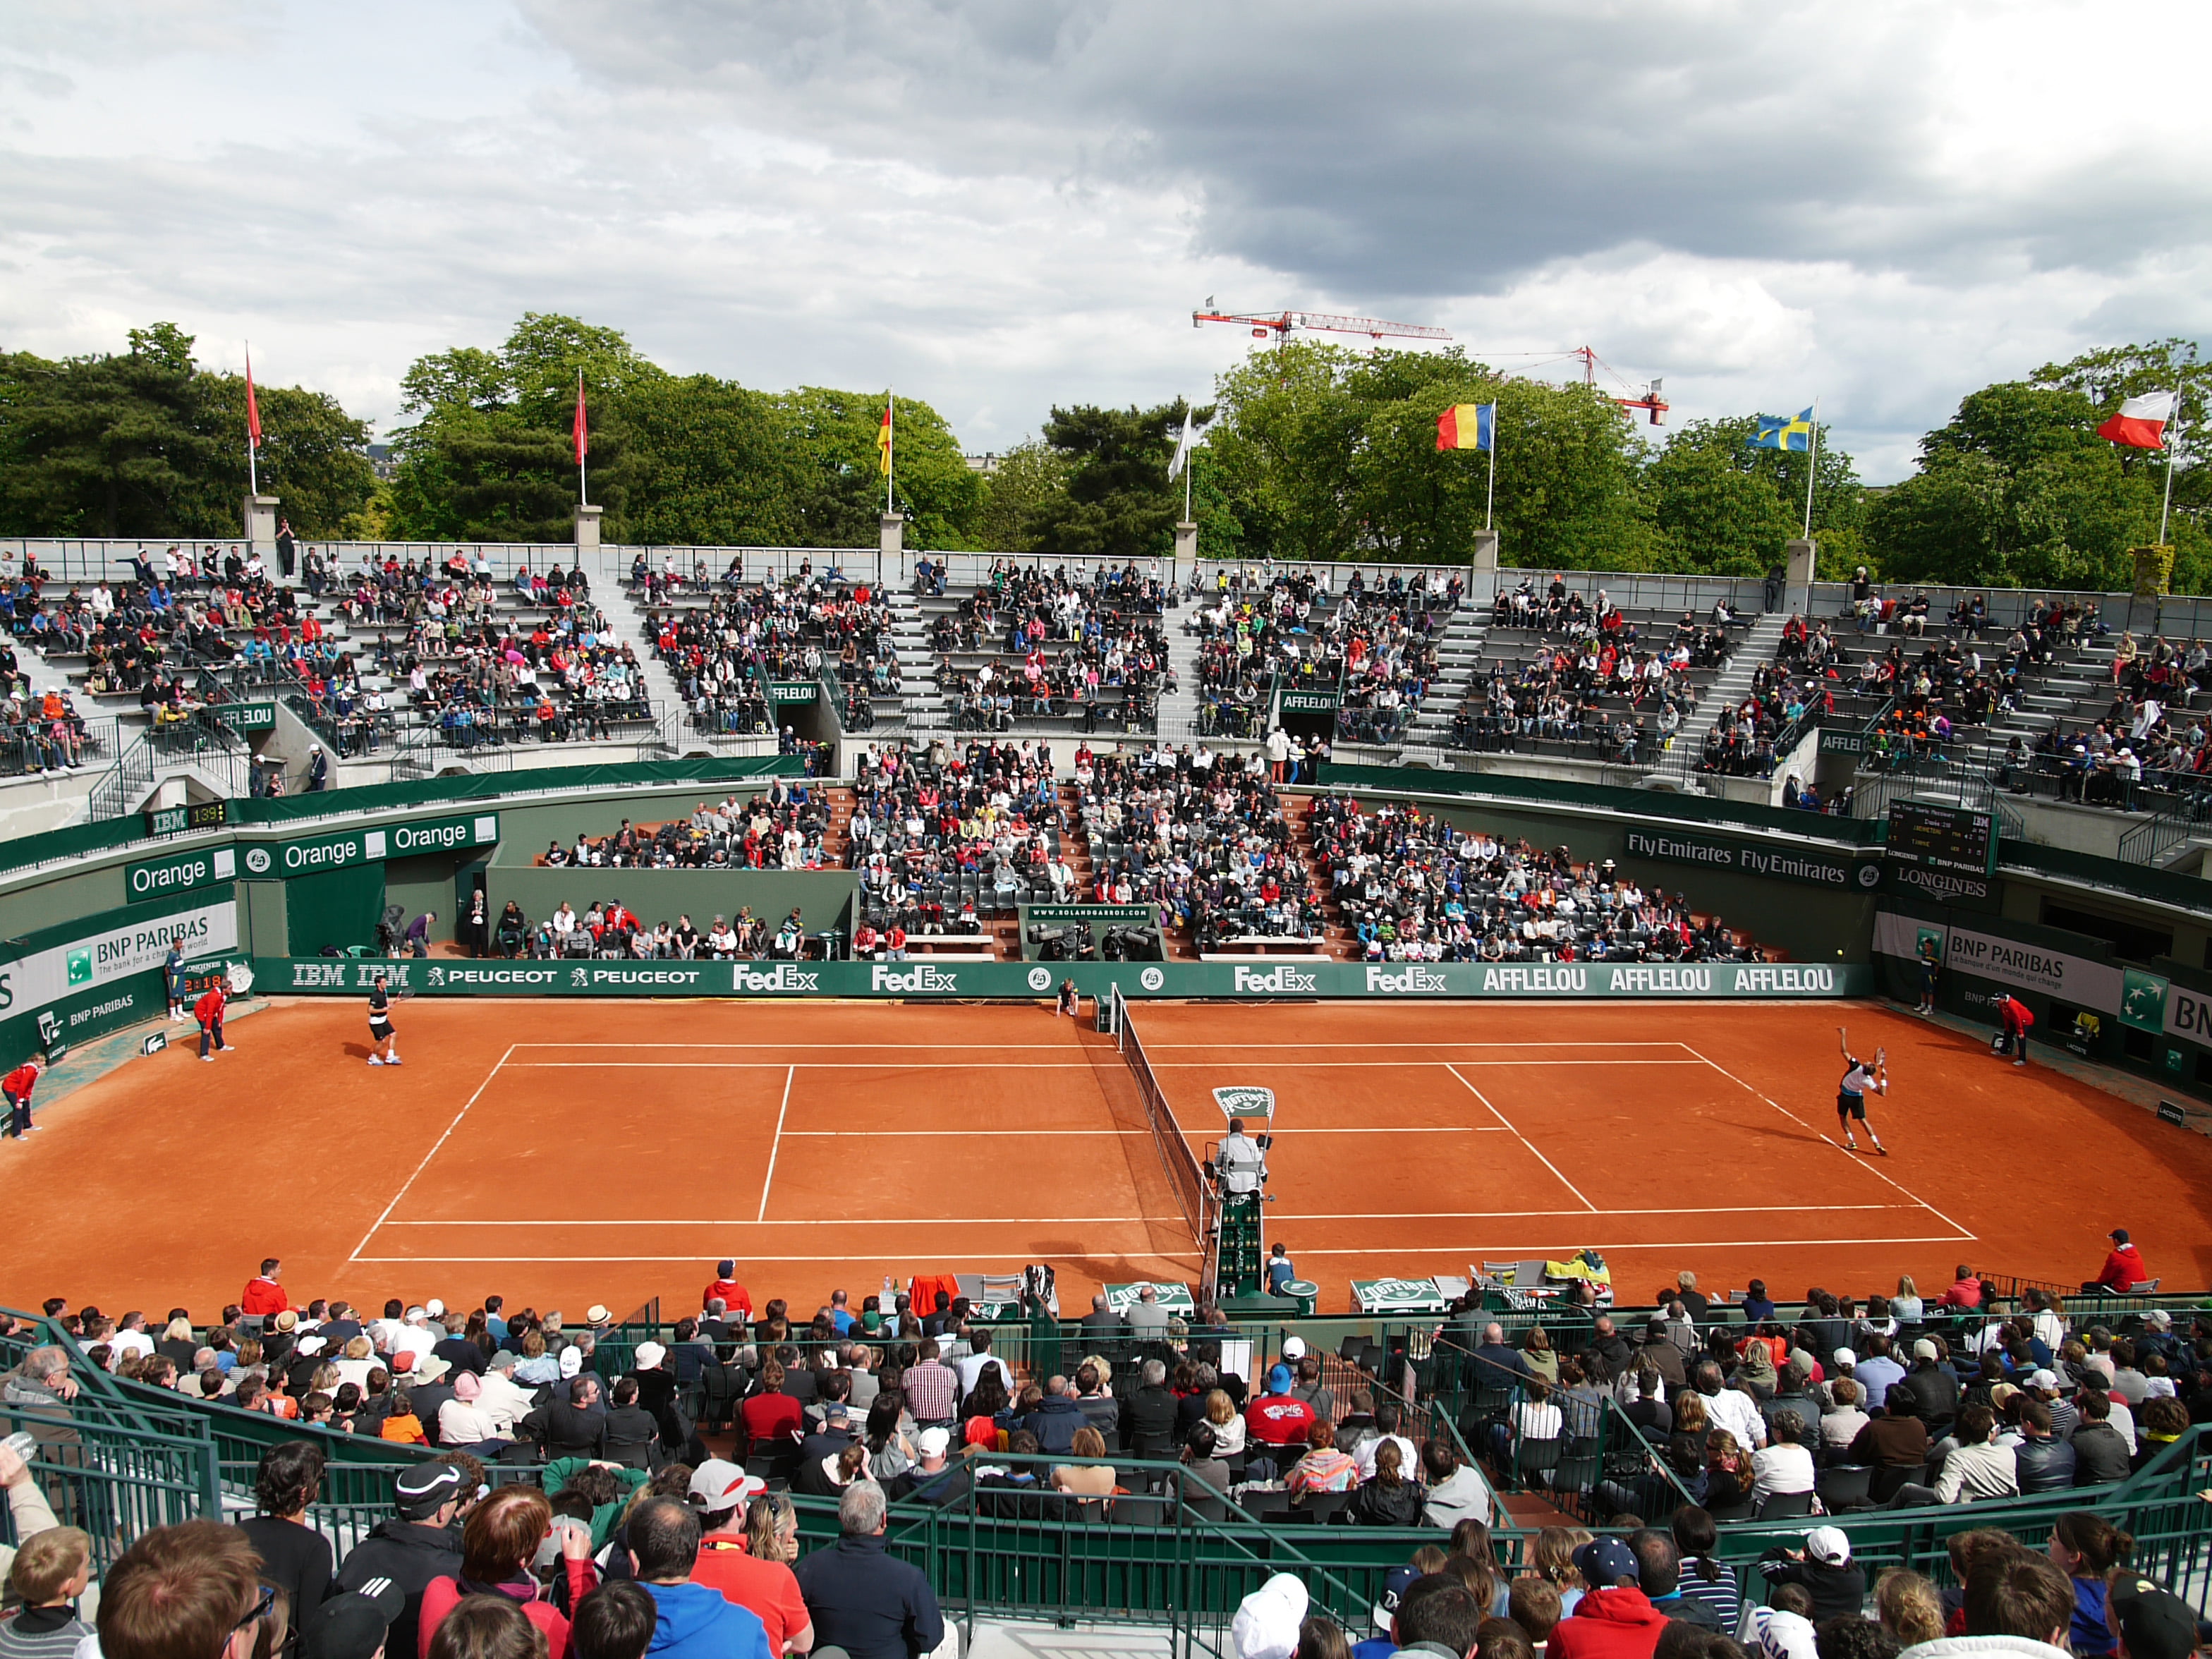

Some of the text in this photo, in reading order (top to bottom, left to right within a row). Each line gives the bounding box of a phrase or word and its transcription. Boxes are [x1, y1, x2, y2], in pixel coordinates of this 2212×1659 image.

[774, 687, 816, 700] FFLELOU
[153, 810, 186, 833] IBM
[194, 806, 217, 823] 139
[395, 825, 467, 848] Orange
[286, 840, 356, 868] Orange
[1658, 837, 1732, 864] Emirates
[1888, 849, 1919, 861] LONGINES
[133, 861, 206, 892] Orange
[1770, 854, 1846, 883] Emirates
[1937, 858, 1985, 874] BNP PARIBAS
[1897, 868, 1987, 898] LONGINES
[97, 917, 208, 964] BNP PARIBAS
[99, 965, 111, 975] The
[114, 959, 131, 971] bank
[133, 955, 143, 967] for
[187, 937, 209, 950] world
[1952, 935, 2064, 978] BNP PARIBAS
[293, 964, 346, 986] IBM
[357, 964, 410, 987] IBM
[449, 970, 557, 983] PEUGEOT
[593, 969, 700, 984] PEUGEOT
[733, 964, 819, 991] FedEx
[872, 965, 957, 992] FedEx
[1234, 966, 1317, 992] FedEx
[1366, 966, 1447, 992] FedEx
[1483, 968, 1586, 992] AFFLELOU
[1610, 968, 1710, 992] AFFLELOU
[1734, 968, 1834, 992] AFFLELOU
[1959, 955, 1985, 968] banque
[1986, 961, 2001, 973] d'un
[2002, 967, 2025, 979] monde
[2026, 973, 2037, 983] qui
[2038, 976, 2062, 990] change
[1964, 990, 1986, 1005] BNP
[71, 994, 133, 1026] BNP PARIBAS
[2066, 1041, 2088, 1055] LACOSTE
[2159, 1106, 2183, 1122] LACOSTE
